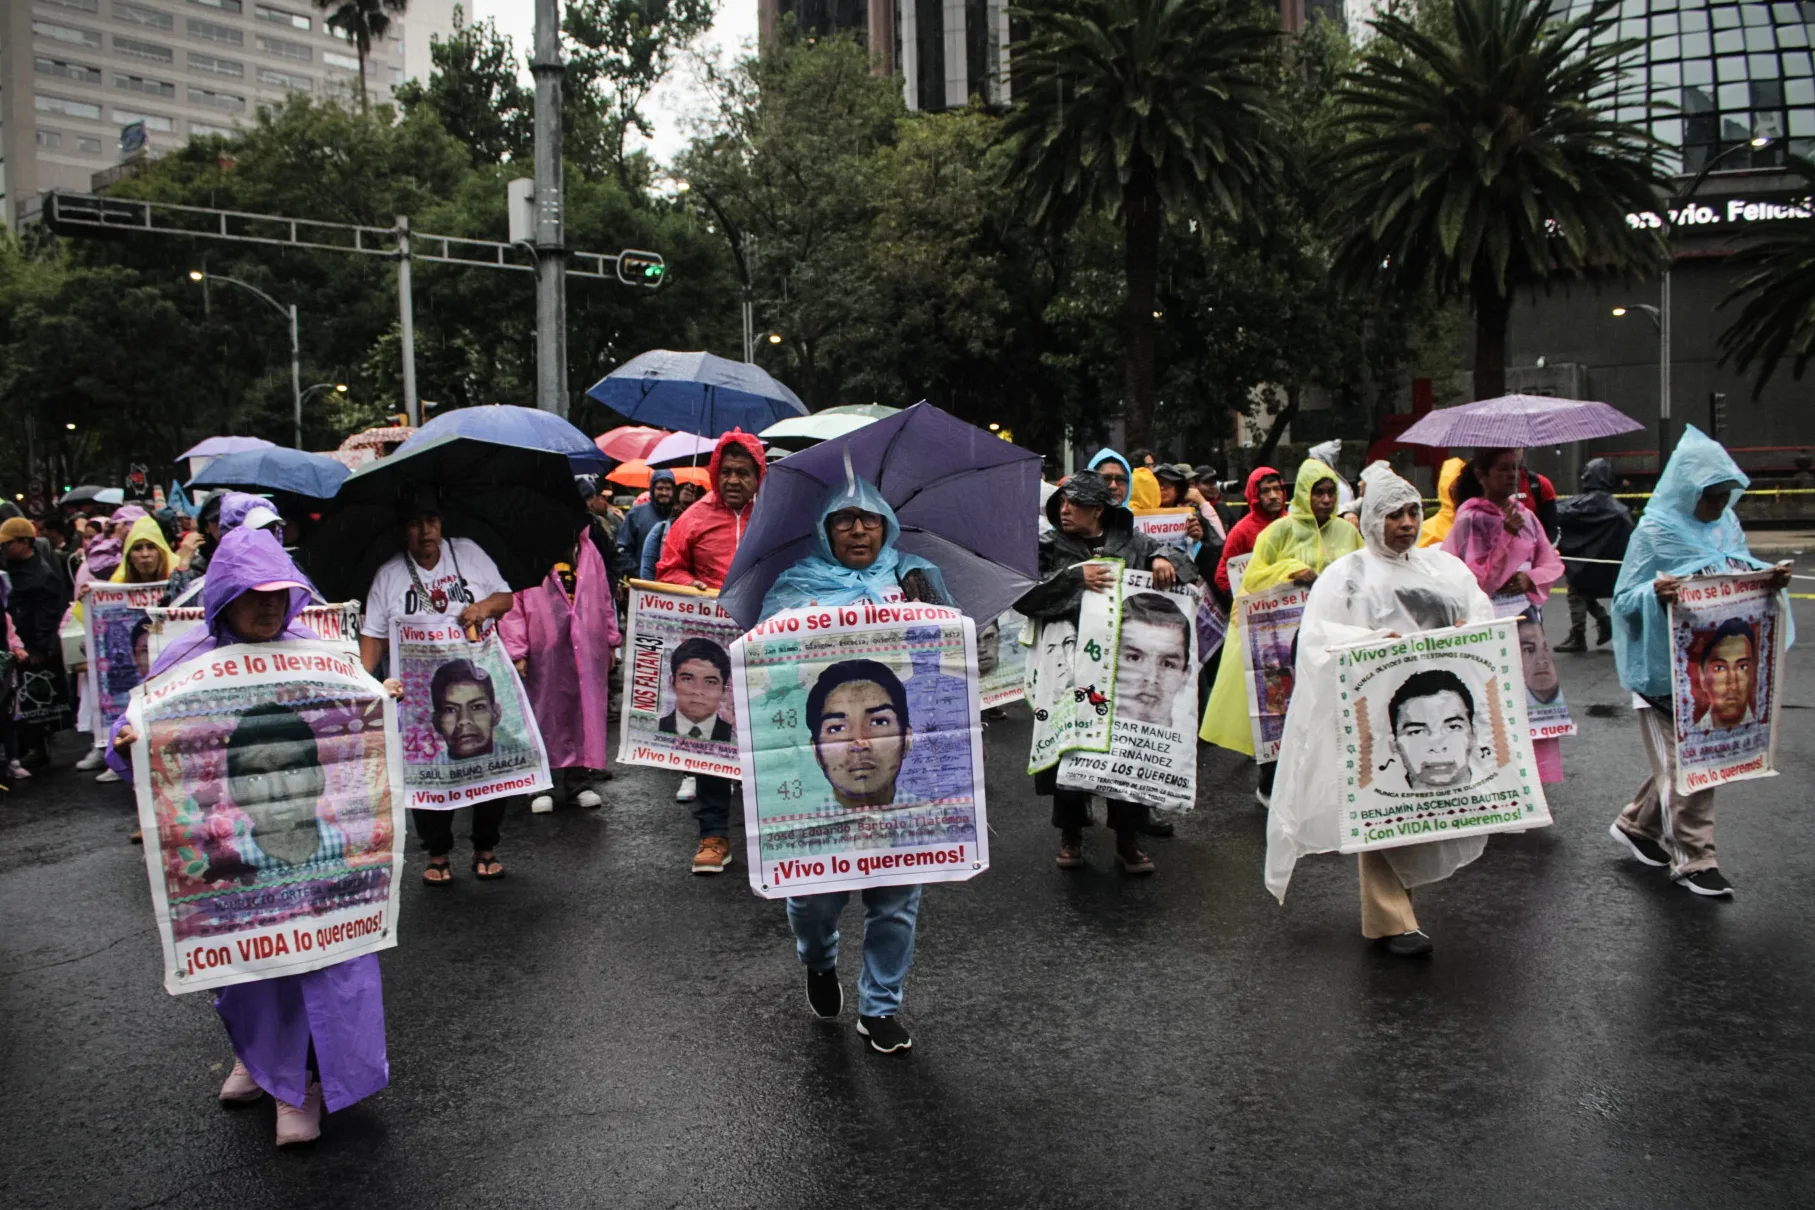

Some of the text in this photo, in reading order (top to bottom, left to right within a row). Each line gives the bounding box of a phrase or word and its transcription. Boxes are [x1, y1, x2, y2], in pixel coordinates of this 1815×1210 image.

[1128, 574, 1142, 587] SE
[1704, 586, 1717, 598] se
[1720, 582, 1731, 596] lo
[92, 590, 124, 605] ¡Vivo
[128, 588, 147, 607] NOS
[640, 594, 674, 611] ¡Vivo
[678, 602, 695, 613] se
[698, 602, 712, 616] lo
[1249, 599, 1279, 615] ¡Vivo
[1282, 594, 1297, 605] se
[400, 625, 425, 643] ¡Vivo
[428, 630, 444, 641] se
[448, 625, 461, 640] lo
[747, 617, 800, 641] ¡Vivo
[807, 613, 831, 630] se
[838, 607, 858, 627] lo
[1083, 638, 1102, 661] 43
[1349, 628, 1494, 666] ¡Vivo se lo llevaron!
[146, 669, 205, 704] ¡Vivo
[211, 657, 239, 678] se
[244, 655, 267, 674] lo
[274, 653, 359, 681] llevaron!
[634, 633, 664, 712] NOS FALTAN 43!
[1354, 672, 1374, 691] NUNCA
[1376, 658, 1402, 674] OLVIDES
[1403, 655, 1418, 663] QUE
[983, 687, 1023, 705] queremo
[772, 708, 798, 729] 43
[1111, 734, 1171, 753] GONZÁLEZ
[1142, 725, 1183, 743] MANUEL
[450, 765, 483, 779] BRUNO
[488, 755, 527, 771] GARCÍA
[632, 747, 665, 762] ¡Vivo
[669, 753, 681, 765] lo
[685, 758, 742, 775] queremo
[1111, 747, 1173, 768] ERNÁNDEZ
[1708, 768, 1718, 781] lo
[1720, 754, 1763, 781] queremos!
[1069, 756, 1190, 788] ¡VIVOS LOS QUEREMOS!
[412, 790, 445, 806] ¡Vivo
[449, 790, 461, 802] lo
[466, 774, 536, 800] queremos!
[777, 779, 803, 800] 43
[1374, 788, 1399, 798] NUNCA
[1360, 789, 1520, 820] BENJAMÍN ASCENCIO BAUTISTA
[767, 830, 795, 842] José
[803, 822, 851, 838] Eduardo
[858, 818, 907, 831] Bartolo
[915, 815, 969, 827] Tlatempa
[1365, 808, 1522, 844] ¡Con VIDA lo queremos!
[774, 845, 965, 885] ¡Vivo lo queremos!
[186, 945, 232, 975] ¡Con
[237, 932, 290, 963] VIDA
[294, 930, 312, 952] lo
[316, 911, 383, 948] queremos!
